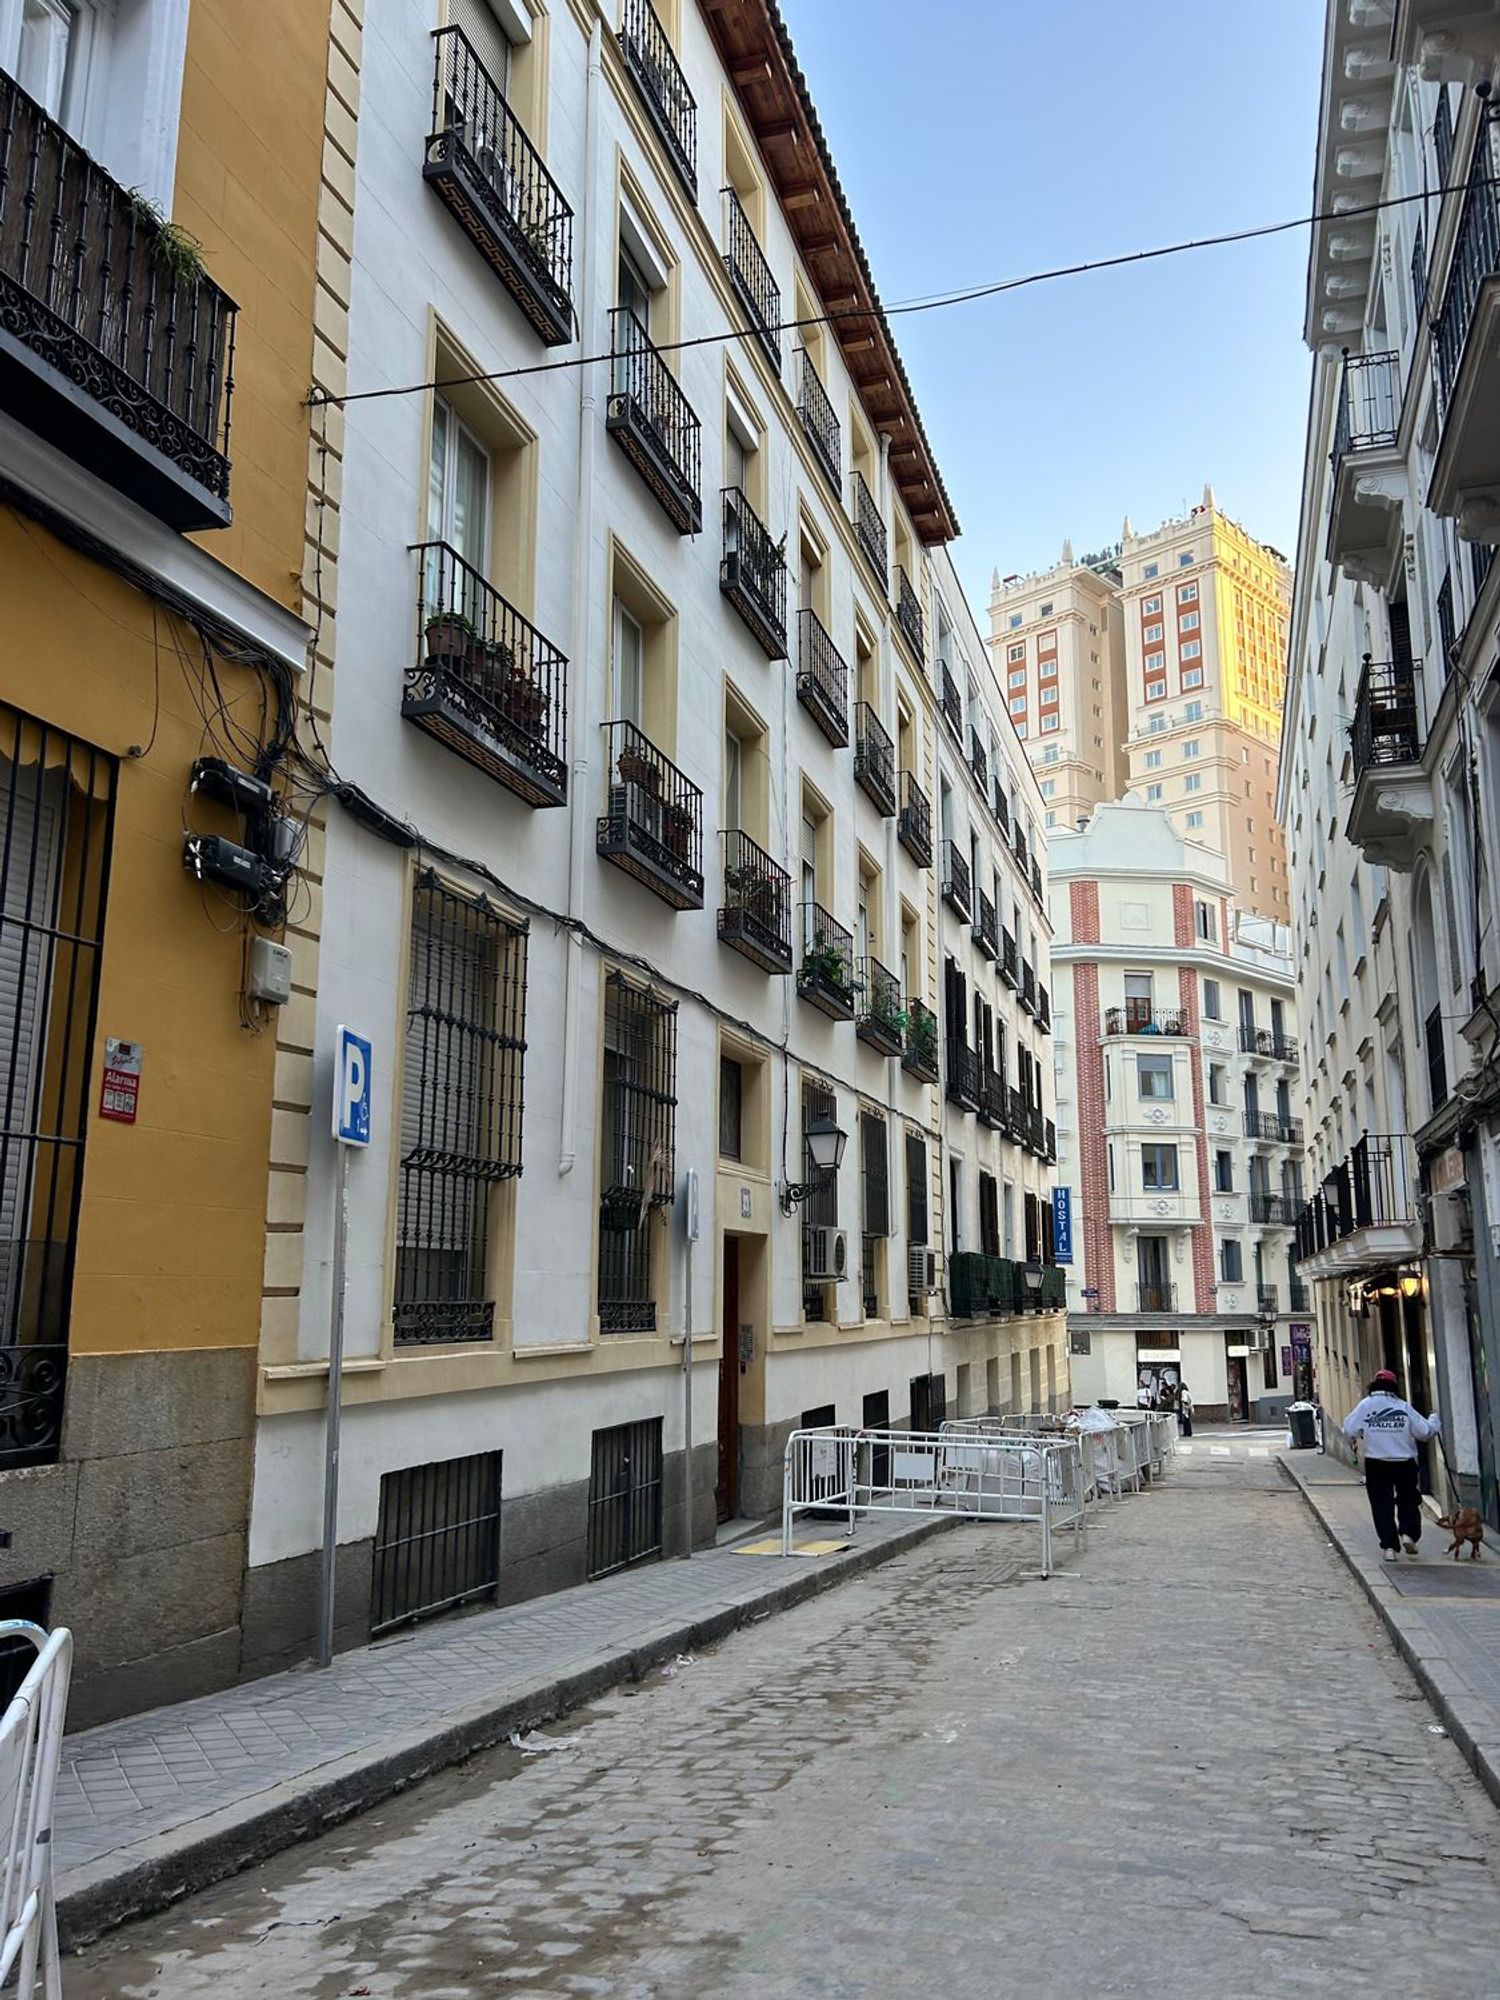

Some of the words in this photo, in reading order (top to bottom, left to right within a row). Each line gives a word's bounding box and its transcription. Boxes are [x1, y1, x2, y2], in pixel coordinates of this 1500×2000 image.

[105, 1071, 137, 1088] Alarma
[343, 1041, 365, 1129] P
[1057, 1188, 1068, 1252] HOSTAL
